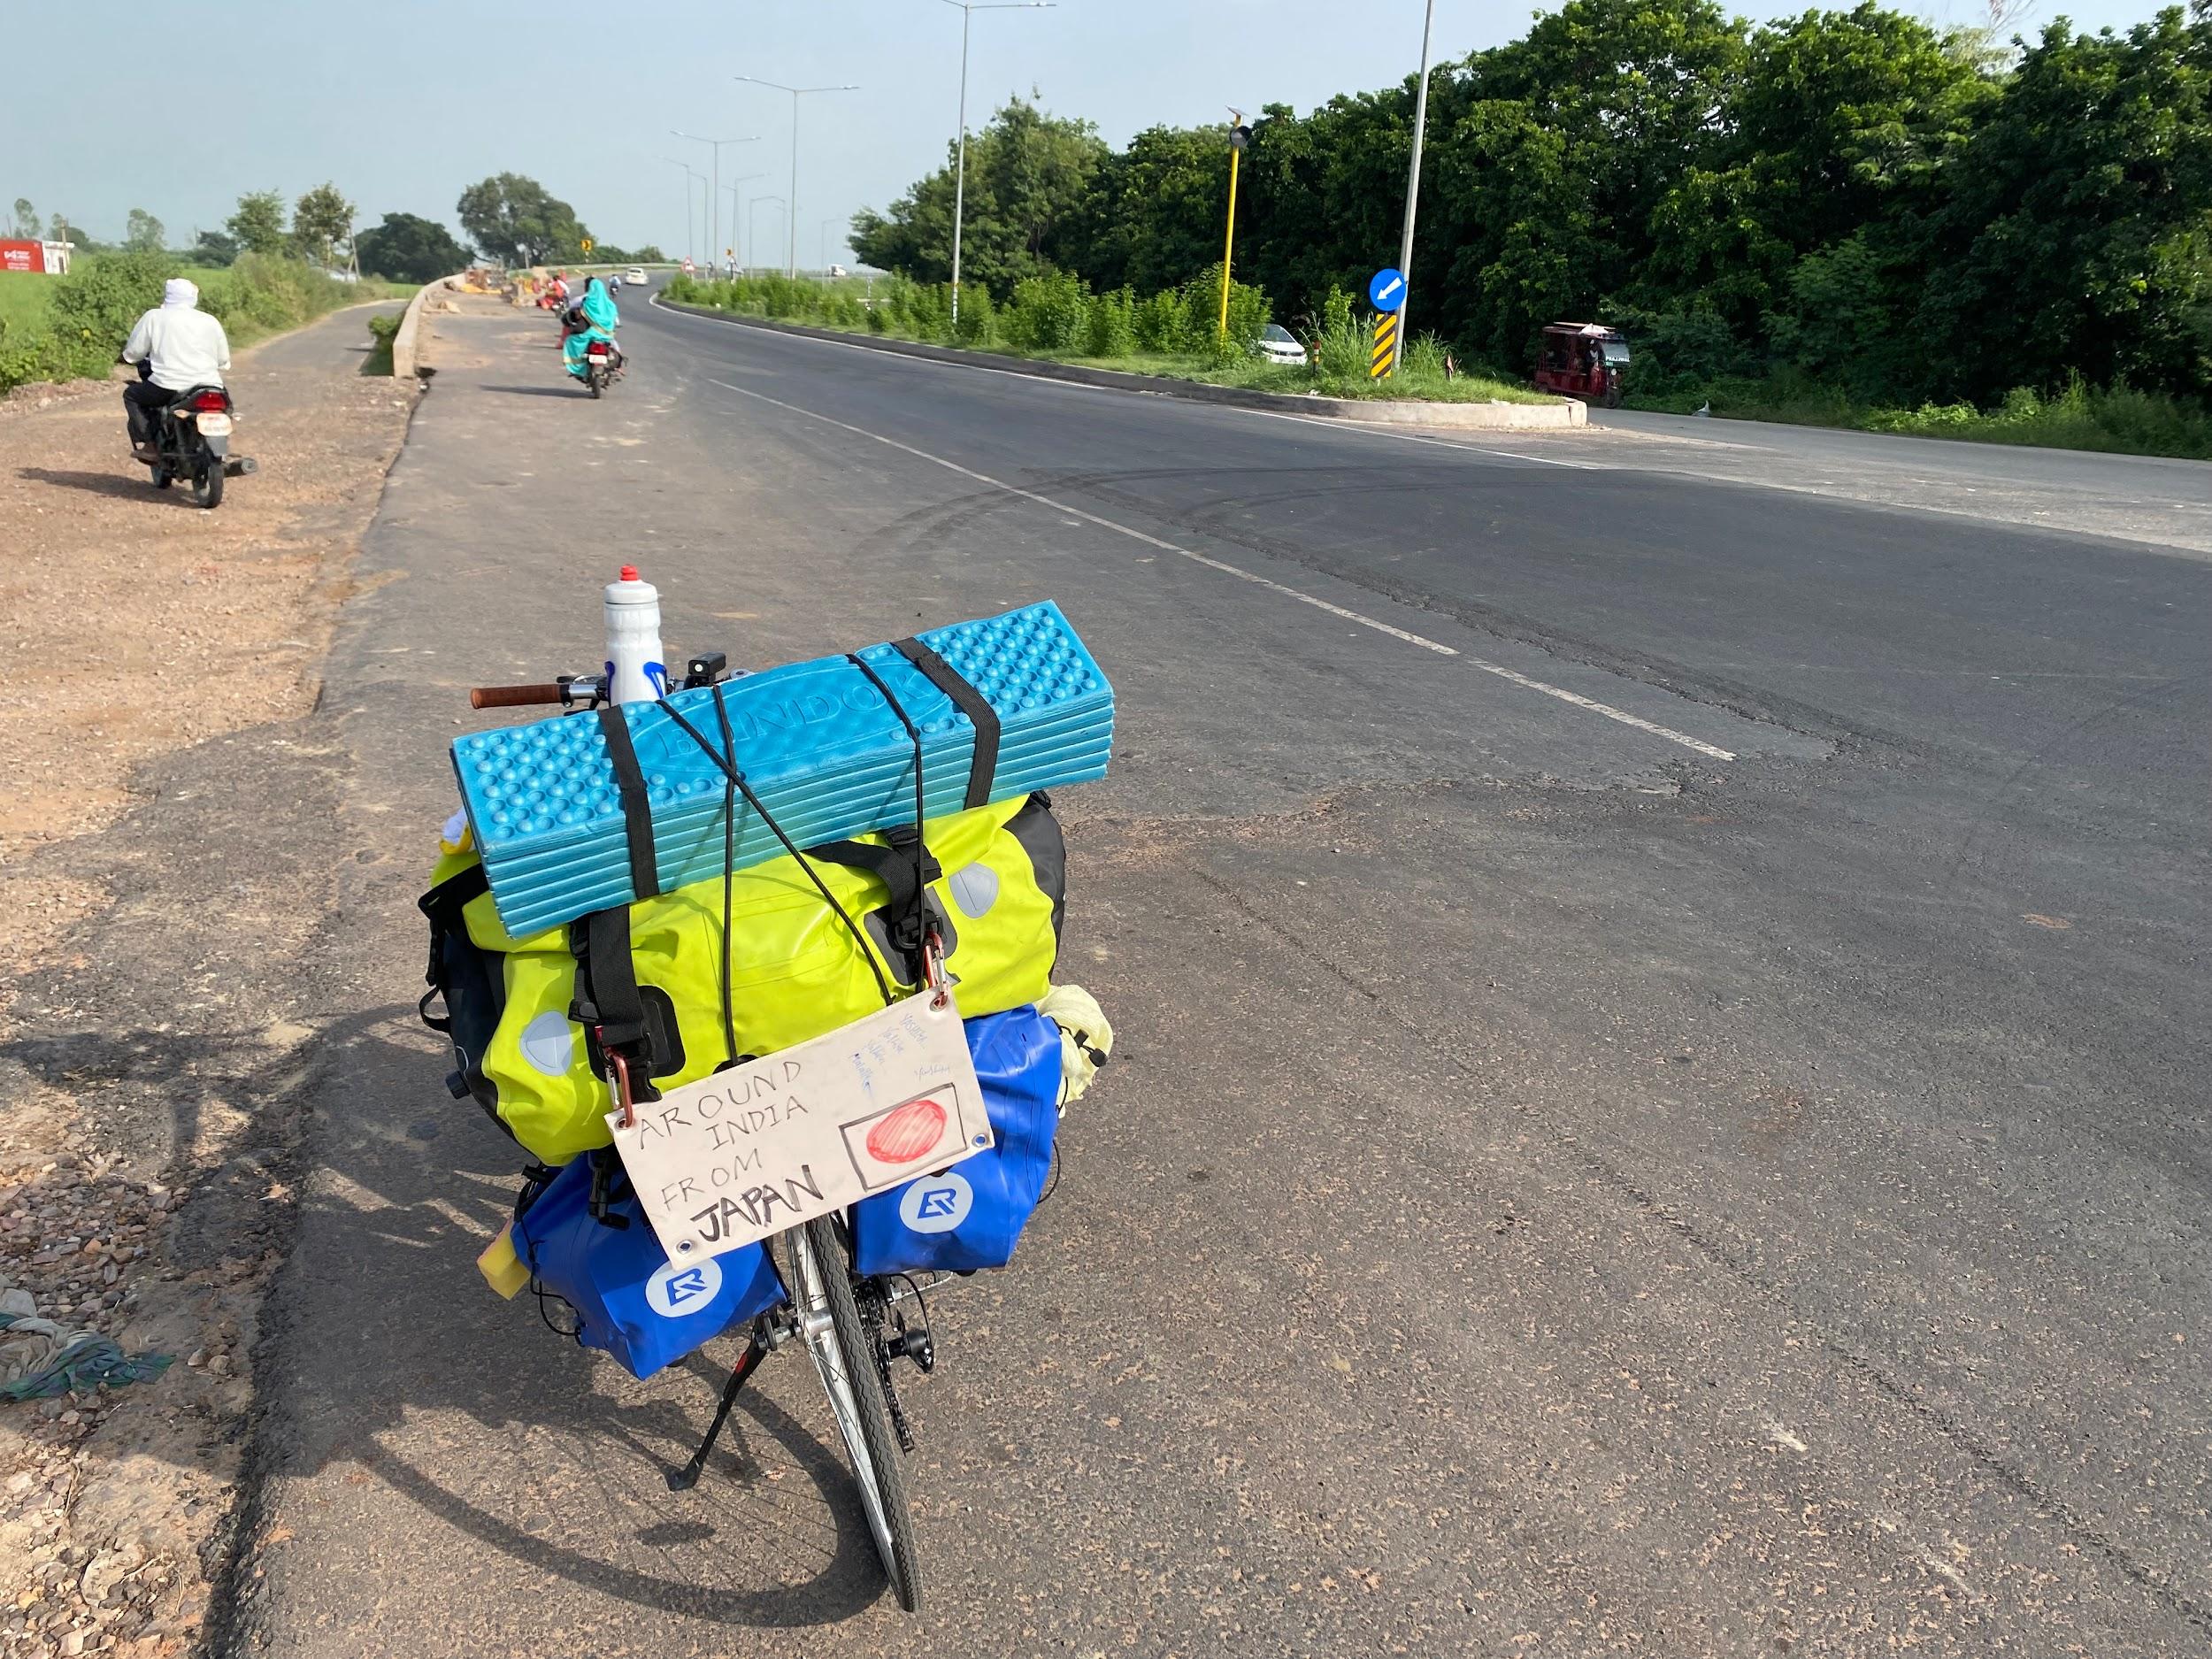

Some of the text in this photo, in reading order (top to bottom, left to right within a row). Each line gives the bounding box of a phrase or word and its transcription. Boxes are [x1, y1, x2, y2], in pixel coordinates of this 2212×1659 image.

[640, 1061, 801, 1149] AROUND
[705, 1095, 809, 1150] INDIA
[661, 1148, 763, 1211] FROM
[689, 1164, 825, 1242] JAPAN
